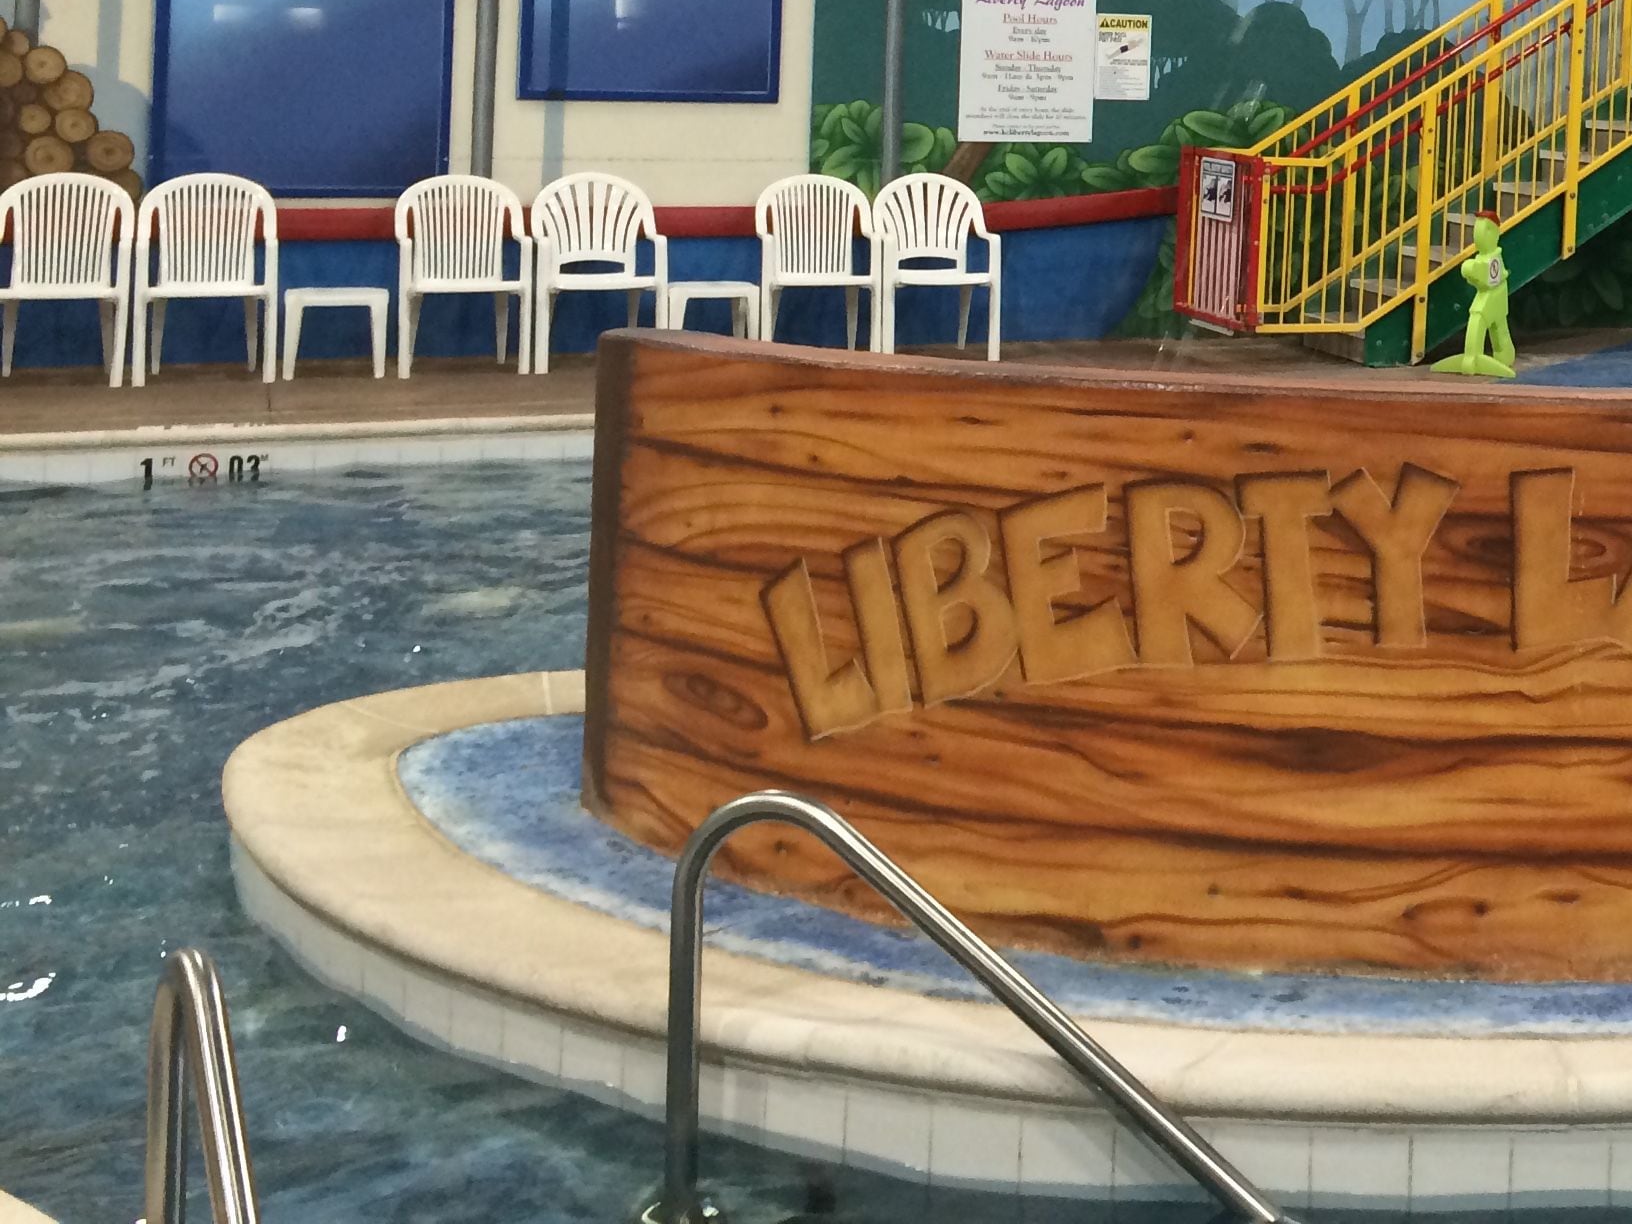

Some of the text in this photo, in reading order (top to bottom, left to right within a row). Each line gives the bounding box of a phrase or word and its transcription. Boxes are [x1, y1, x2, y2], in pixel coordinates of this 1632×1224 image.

[1028, 14, 1057, 25] Hours
[1110, 19, 1148, 28] CAUTION
[1044, 51, 1073, 62] Hours
[140, 457, 176, 480] 1 FT
[759, 462, 1462, 742] LIBERTY
